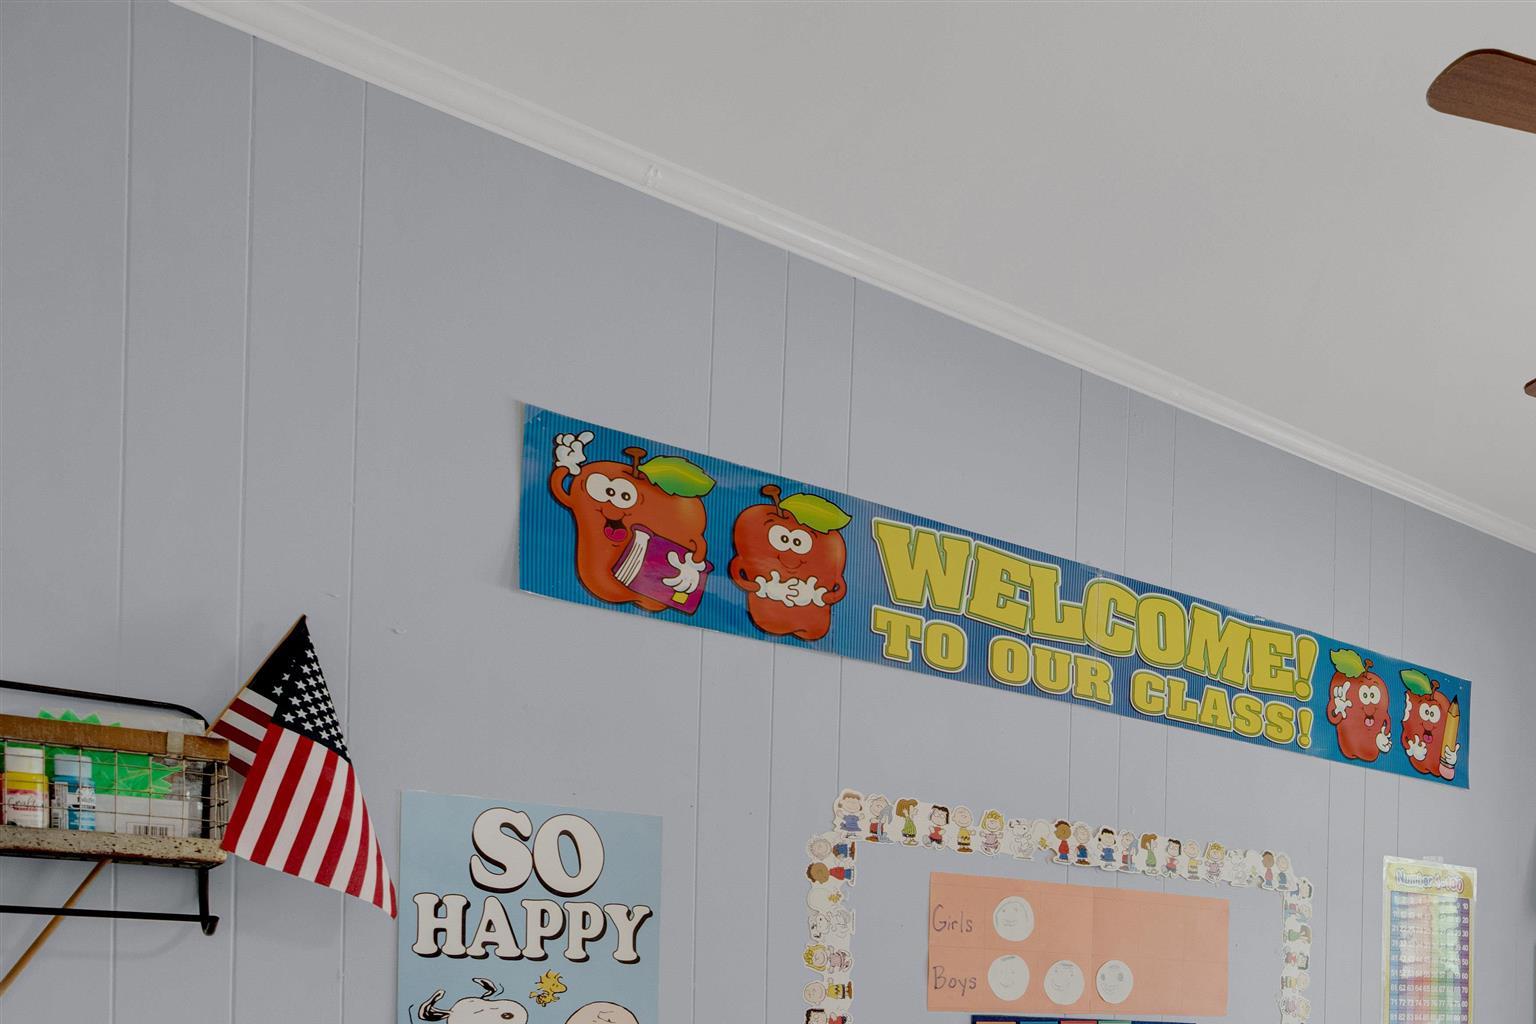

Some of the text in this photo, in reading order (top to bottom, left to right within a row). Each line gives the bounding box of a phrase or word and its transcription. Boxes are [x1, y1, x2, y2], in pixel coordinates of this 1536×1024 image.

[872, 517, 1318, 701] WELCOME!
[871, 605, 1314, 749] TO OUR CLASS!
[469, 807, 605, 897] SO
[411, 892, 653, 964] HAPPY
[932, 903, 973, 933] Girls
[932, 965, 977, 997] Boys
